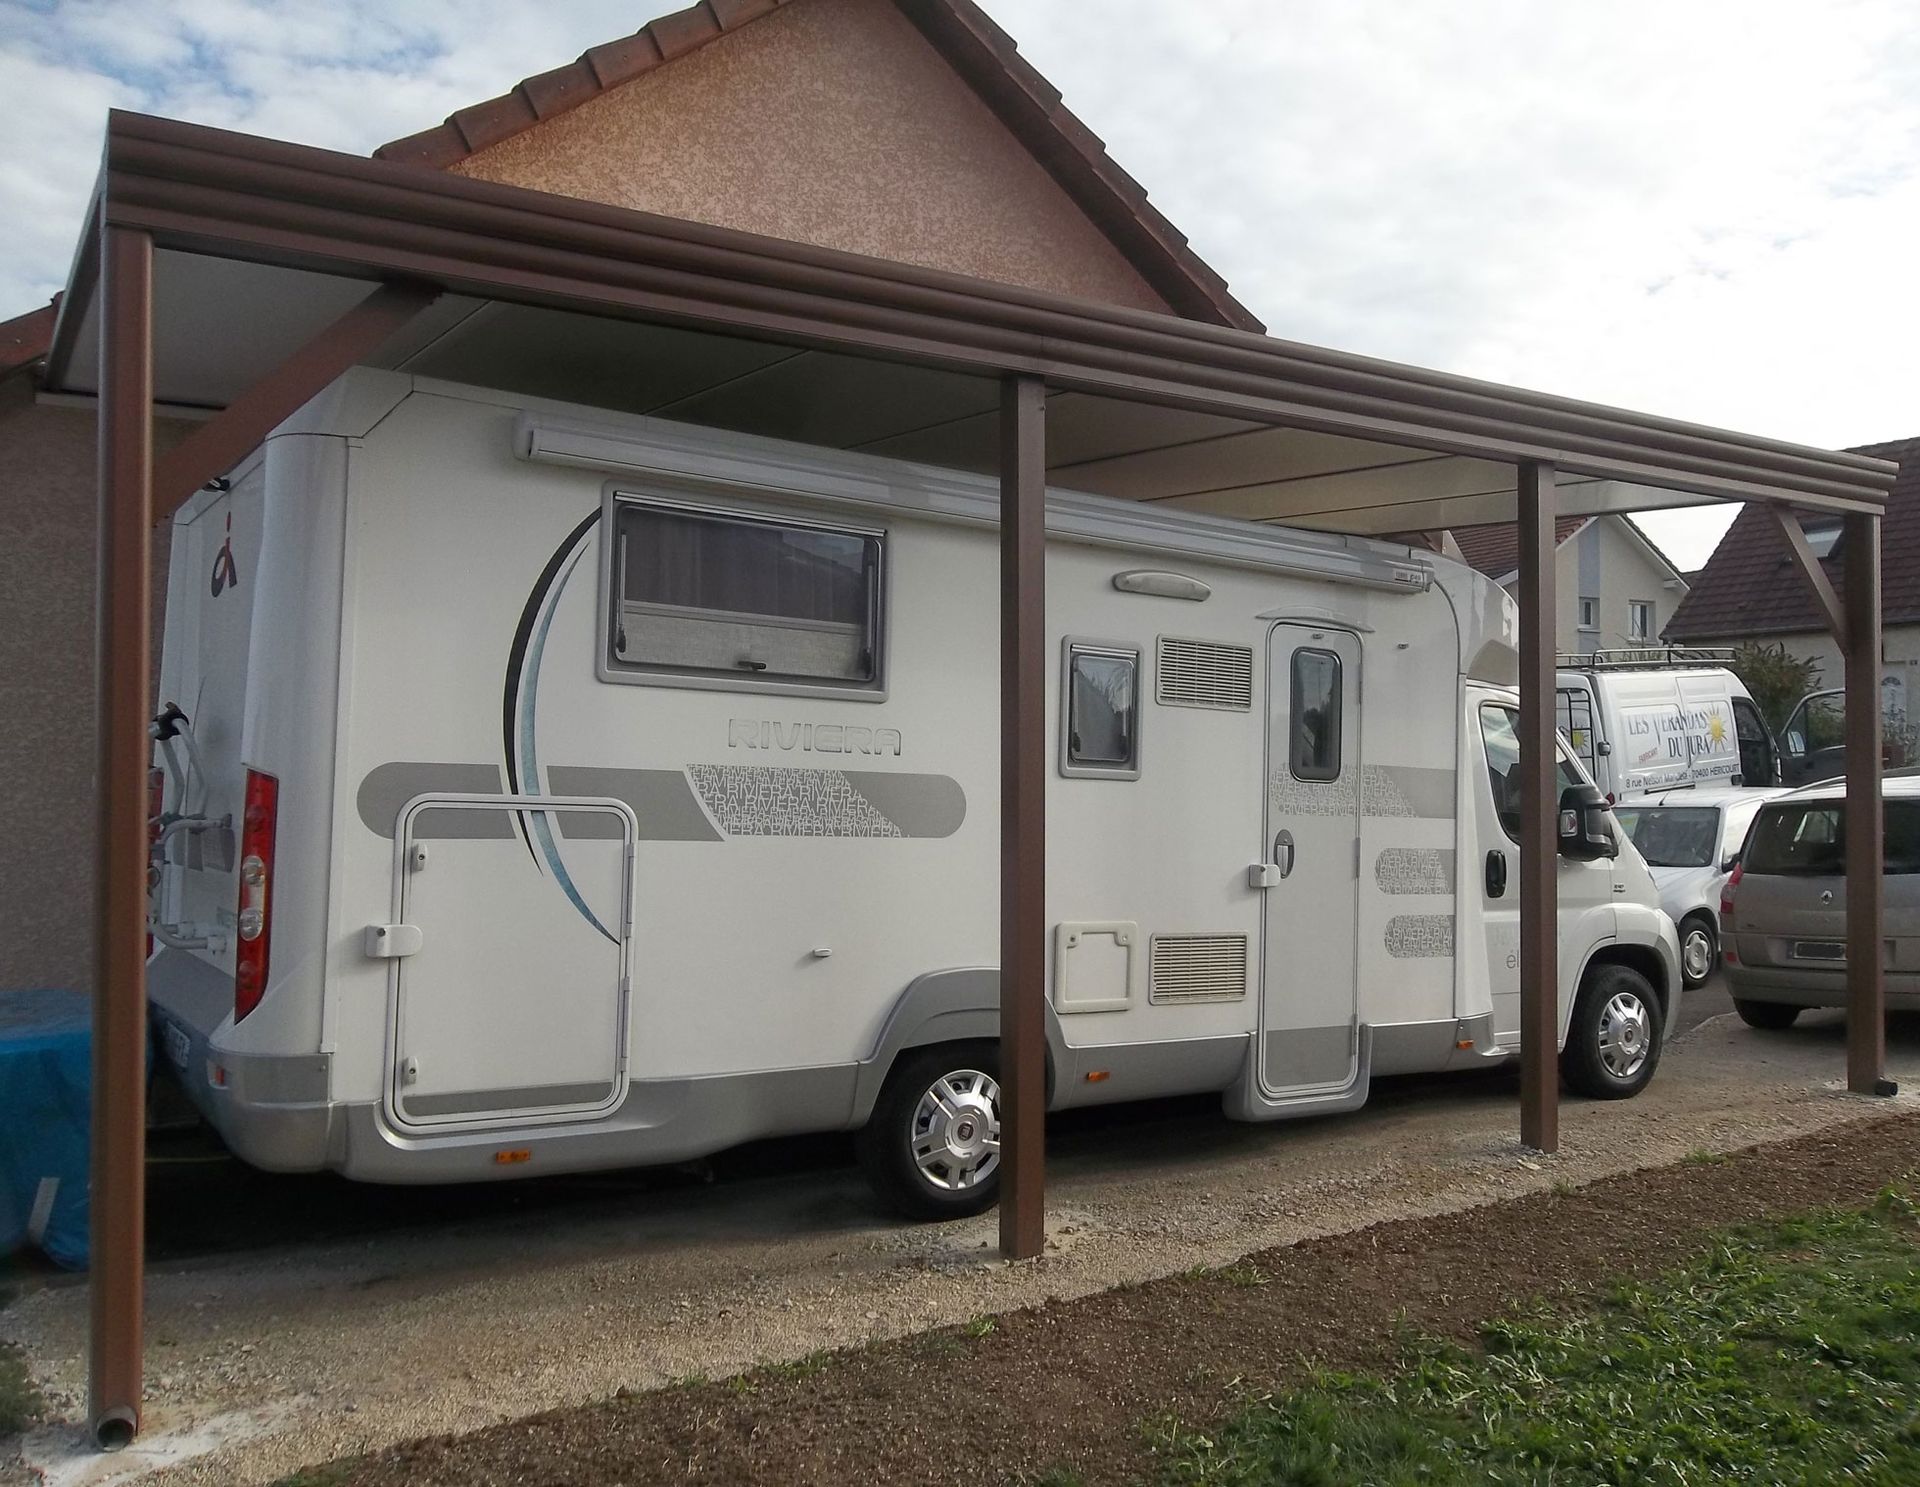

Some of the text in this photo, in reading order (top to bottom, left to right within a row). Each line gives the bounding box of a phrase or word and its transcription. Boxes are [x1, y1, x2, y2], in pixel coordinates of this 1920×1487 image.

[728, 718, 902, 756] RIVIERA
[1627, 710, 1709, 746] LES VERANDAS
[1668, 734, 1711, 769] DU JURA
[1625, 778, 1631, 788] 8
[1632, 779, 1642, 787] rue
